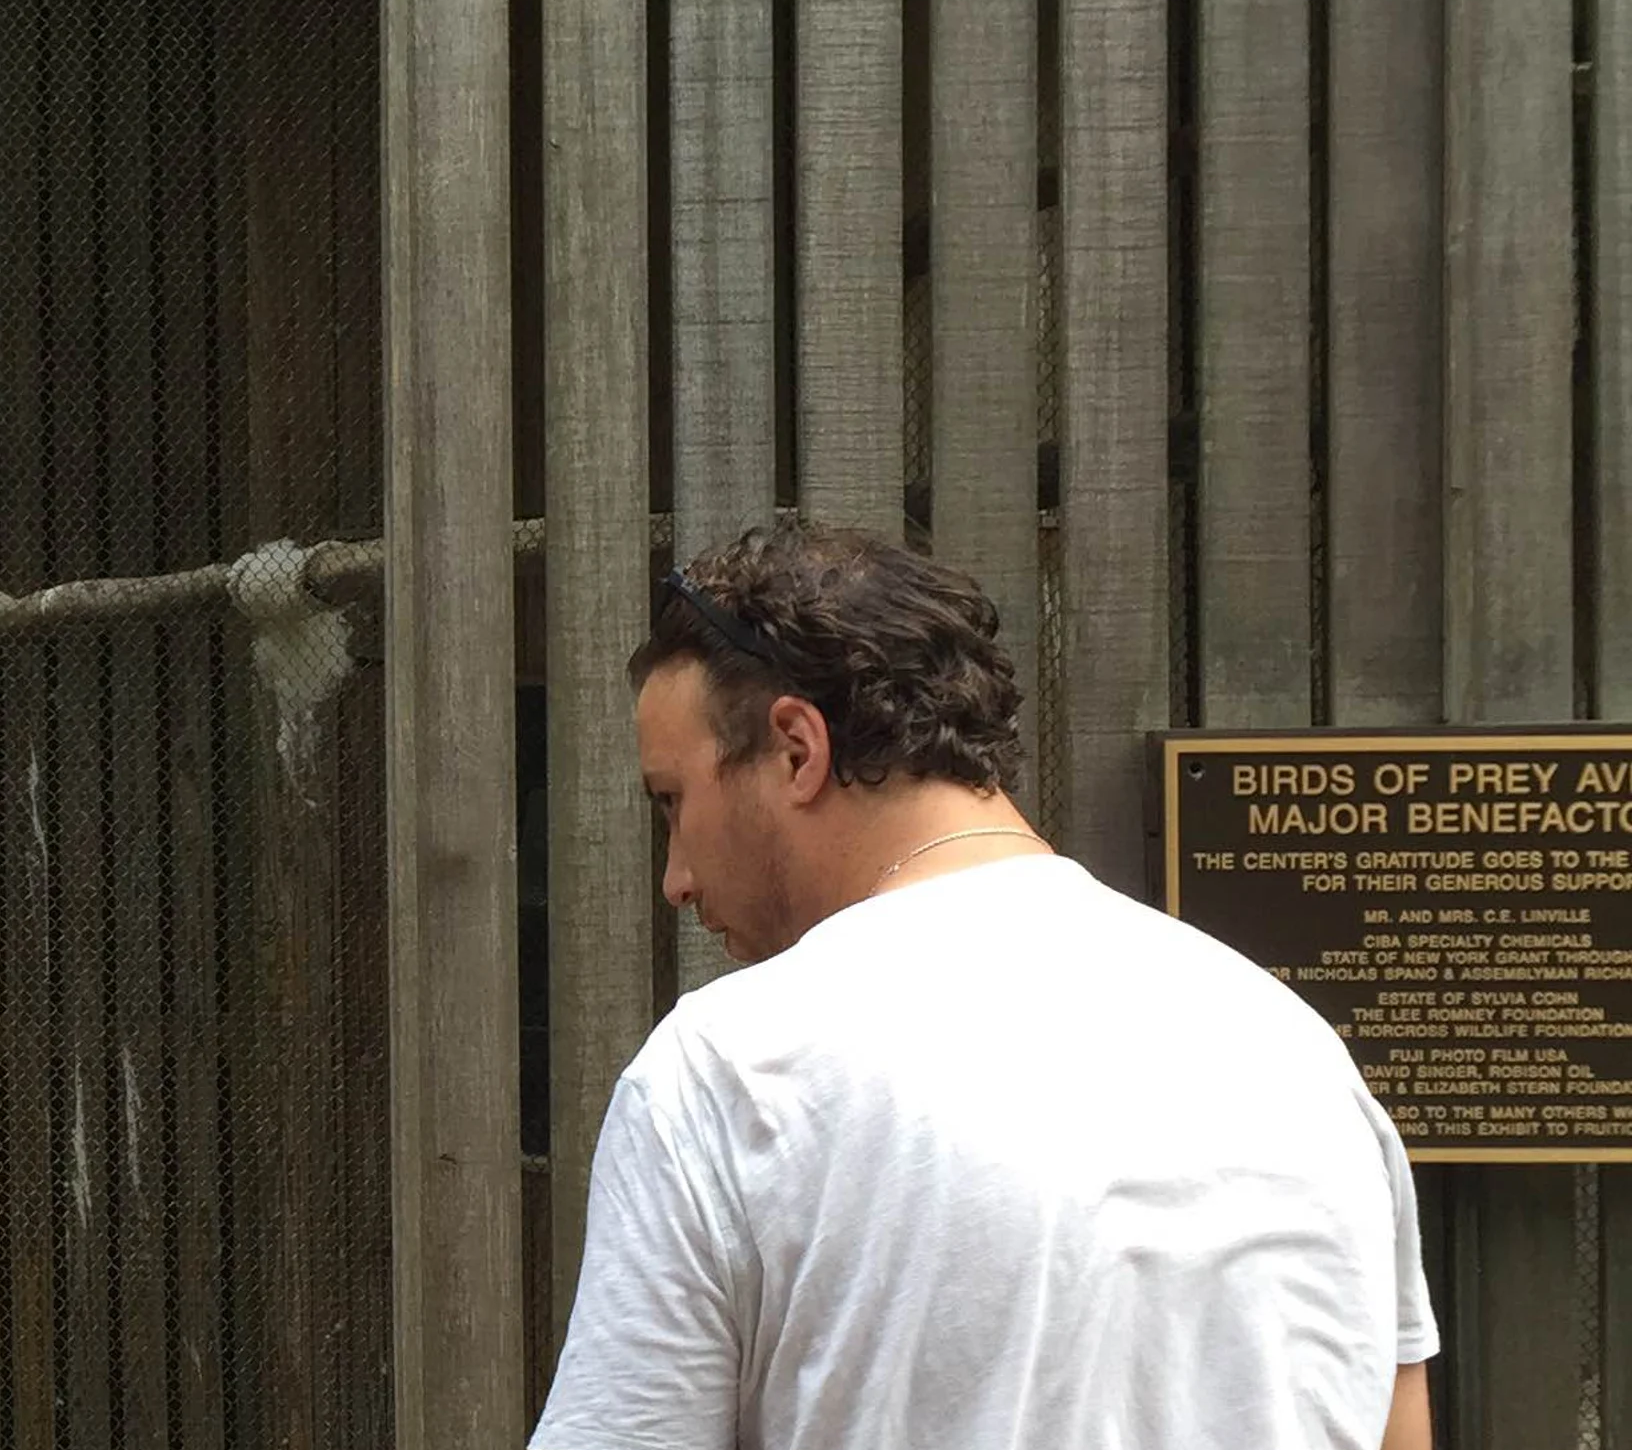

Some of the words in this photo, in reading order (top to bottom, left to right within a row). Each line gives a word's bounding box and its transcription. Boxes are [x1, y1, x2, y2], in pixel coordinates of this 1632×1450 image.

[1234, 764, 1354, 795] BIRDS
[1375, 764, 1429, 794] OF
[1450, 763, 1558, 793] PREY
[1250, 803, 1387, 834] MAJOR
[1194, 853, 1234, 869] THE
[1244, 852, 1347, 869] CENTER'S
[1356, 851, 1474, 869] GRATITUDE
[1483, 851, 1543, 868] GOES
[1550, 851, 1580, 868] TO
[1586, 851, 1629, 868] THE
[1303, 874, 1345, 891] FOR
[1354, 874, 1416, 891] THEIR
[1426, 873, 1544, 891] GENEROUS
[1364, 910, 1392, 923] MR.
[1399, 910, 1432, 923] AND
[1439, 909, 1478, 923] MRS.
[1484, 909, 1515, 923] C.E.
[1521, 909, 1590, 923] LINVILLE
[1364, 935, 1401, 948] CIBA
[1408, 935, 1494, 948] SPECIALTY
[1499, 935, 1592, 948] CHEMICALS
[1322, 951, 1369, 964] STATE
[1375, 951, 1397, 964] OF
[1404, 951, 1440, 964] NEW
[1446, 951, 1489, 964] YORK
[1495, 951, 1550, 964] GRANT
[1298, 967, 1377, 981] NICHOLAS
[1384, 967, 1438, 981] SPANO
[1444, 967, 1454, 981] &
[1460, 967, 1578, 981] ASSEMBLYMAN
[1378, 992, 1436, 1005] ESTATE
[1442, 992, 1464, 1005] OF
[1472, 992, 1526, 1005] SYLVIA
[1532, 992, 1578, 1005] COHN
[1352, 1008, 1384, 1021] THE
[1391, 1008, 1420, 1021] LEE
[1428, 1008, 1496, 1021] ROMNEY
[1502, 1008, 1604, 1021] FOUNDATION
[1358, 1024, 1448, 1037] NORCROSS
[1454, 1024, 1528, 1037] WILDLIFE
[1390, 1049, 1424, 1062] FUJI
[1431, 1049, 1485, 1062] PHOTO
[1492, 1049, 1528, 1062] FILM
[1535, 1049, 1568, 1062] USA
[1363, 1065, 1410, 1078] DAVID
[1417, 1065, 1482, 1079] SINGER,
[1489, 1065, 1561, 1078] ROBISON
[1567, 1065, 1594, 1078] OIL
[1396, 1081, 1408, 1094] &
[1414, 1081, 1500, 1094] ELIZABETH
[1507, 1081, 1560, 1094] STERN
[1425, 1106, 1446, 1119] TO
[1452, 1106, 1484, 1119] THE
[1490, 1106, 1536, 1119] MANY
[1542, 1106, 1607, 1119] OTHERS
[1435, 1122, 1471, 1135] THIS
[1478, 1122, 1540, 1135] EXHIBIT
[1546, 1122, 1568, 1135] TO
